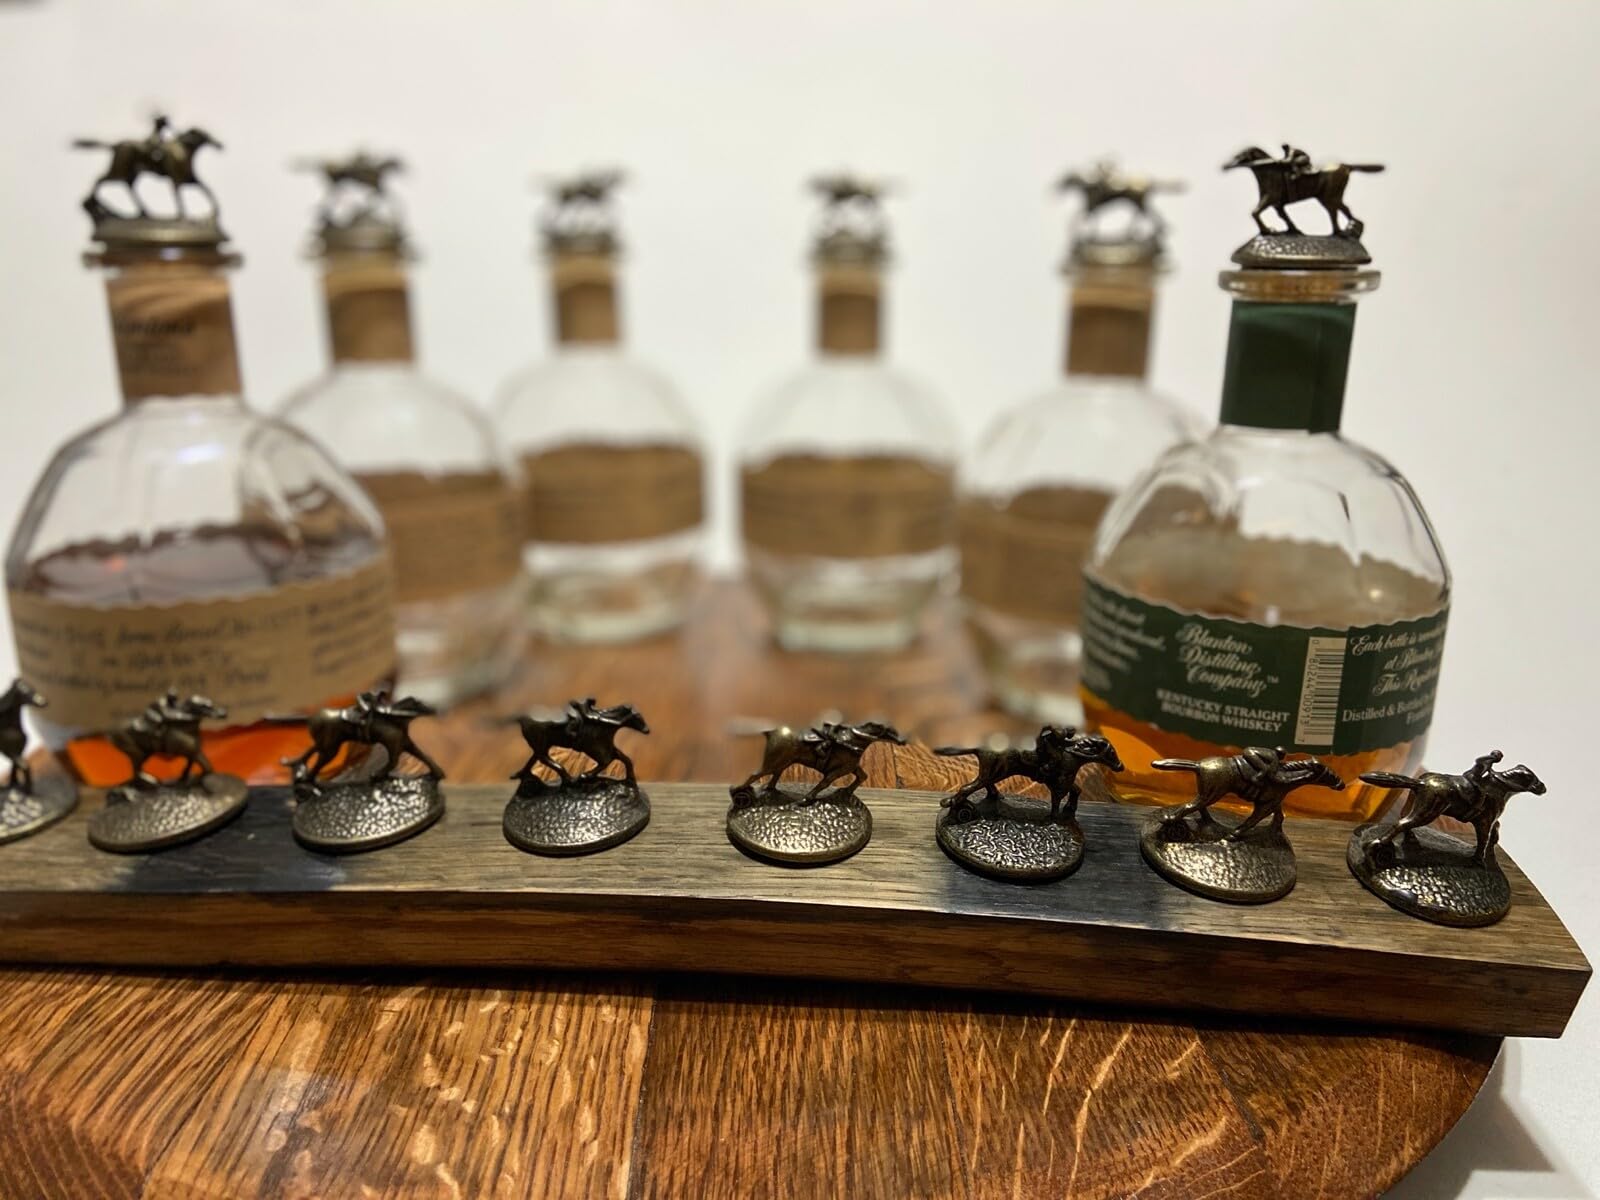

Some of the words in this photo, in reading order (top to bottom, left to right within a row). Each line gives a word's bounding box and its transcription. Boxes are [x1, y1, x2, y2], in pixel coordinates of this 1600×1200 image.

[1175, 622, 1252, 654] Blanton
[1350, 634, 1384, 656] Each
[1179, 645, 1261, 679] Distilling
[1185, 665, 1267, 698] Company
[1156, 688, 1222, 713] KENTUCKY
[1224, 705, 1290, 722] STRAIGHT
[1161, 701, 1220, 723] BOURBON
[1222, 714, 1282, 733] WHISKEY
[1342, 705, 1385, 722] Distilled
